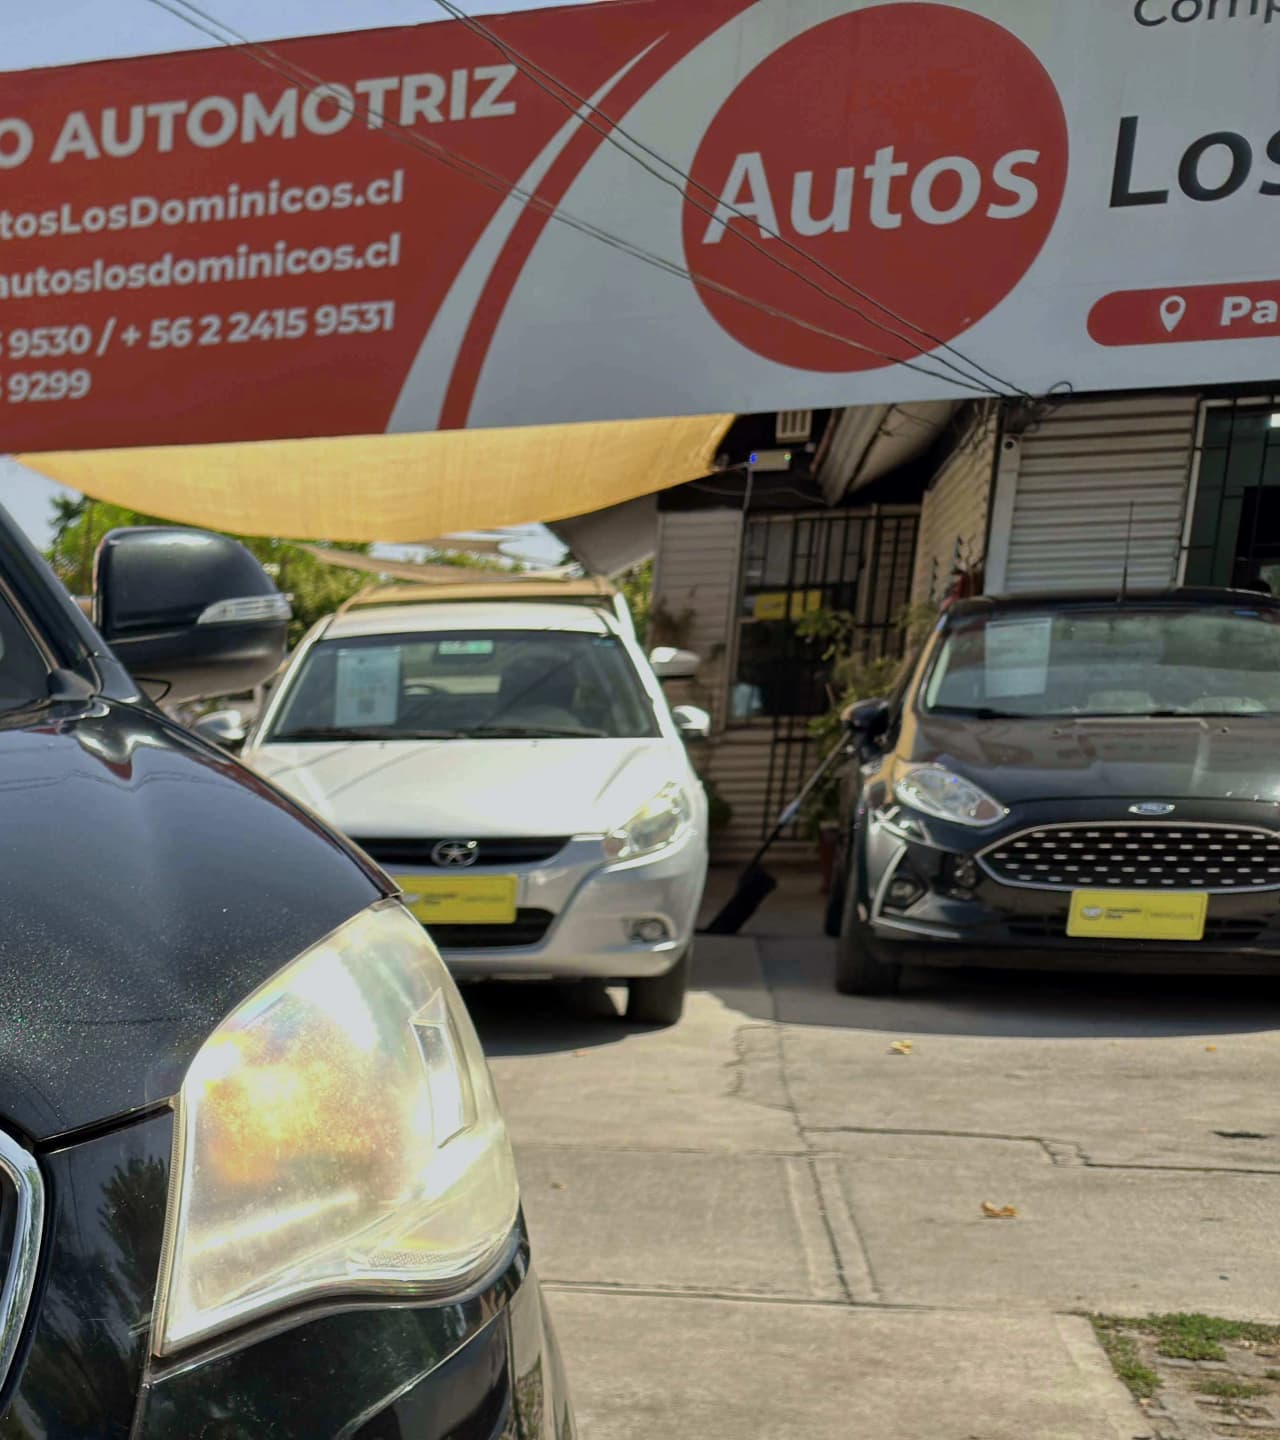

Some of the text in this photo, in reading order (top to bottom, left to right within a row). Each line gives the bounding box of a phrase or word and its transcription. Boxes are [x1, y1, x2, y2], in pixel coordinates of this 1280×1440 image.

[49, 63, 518, 164] AUTOMOTRIZ
[702, 145, 1040, 245] Autos
[7, 324, 93, 360] 9530
[96, 317, 117, 358] /
[121, 324, 140, 346] +
[148, 317, 193, 349] 56
[198, 315, 222, 345] 2
[227, 307, 307, 342] 2415
[314, 300, 395, 336] 9531
[7, 367, 92, 403] 9299
